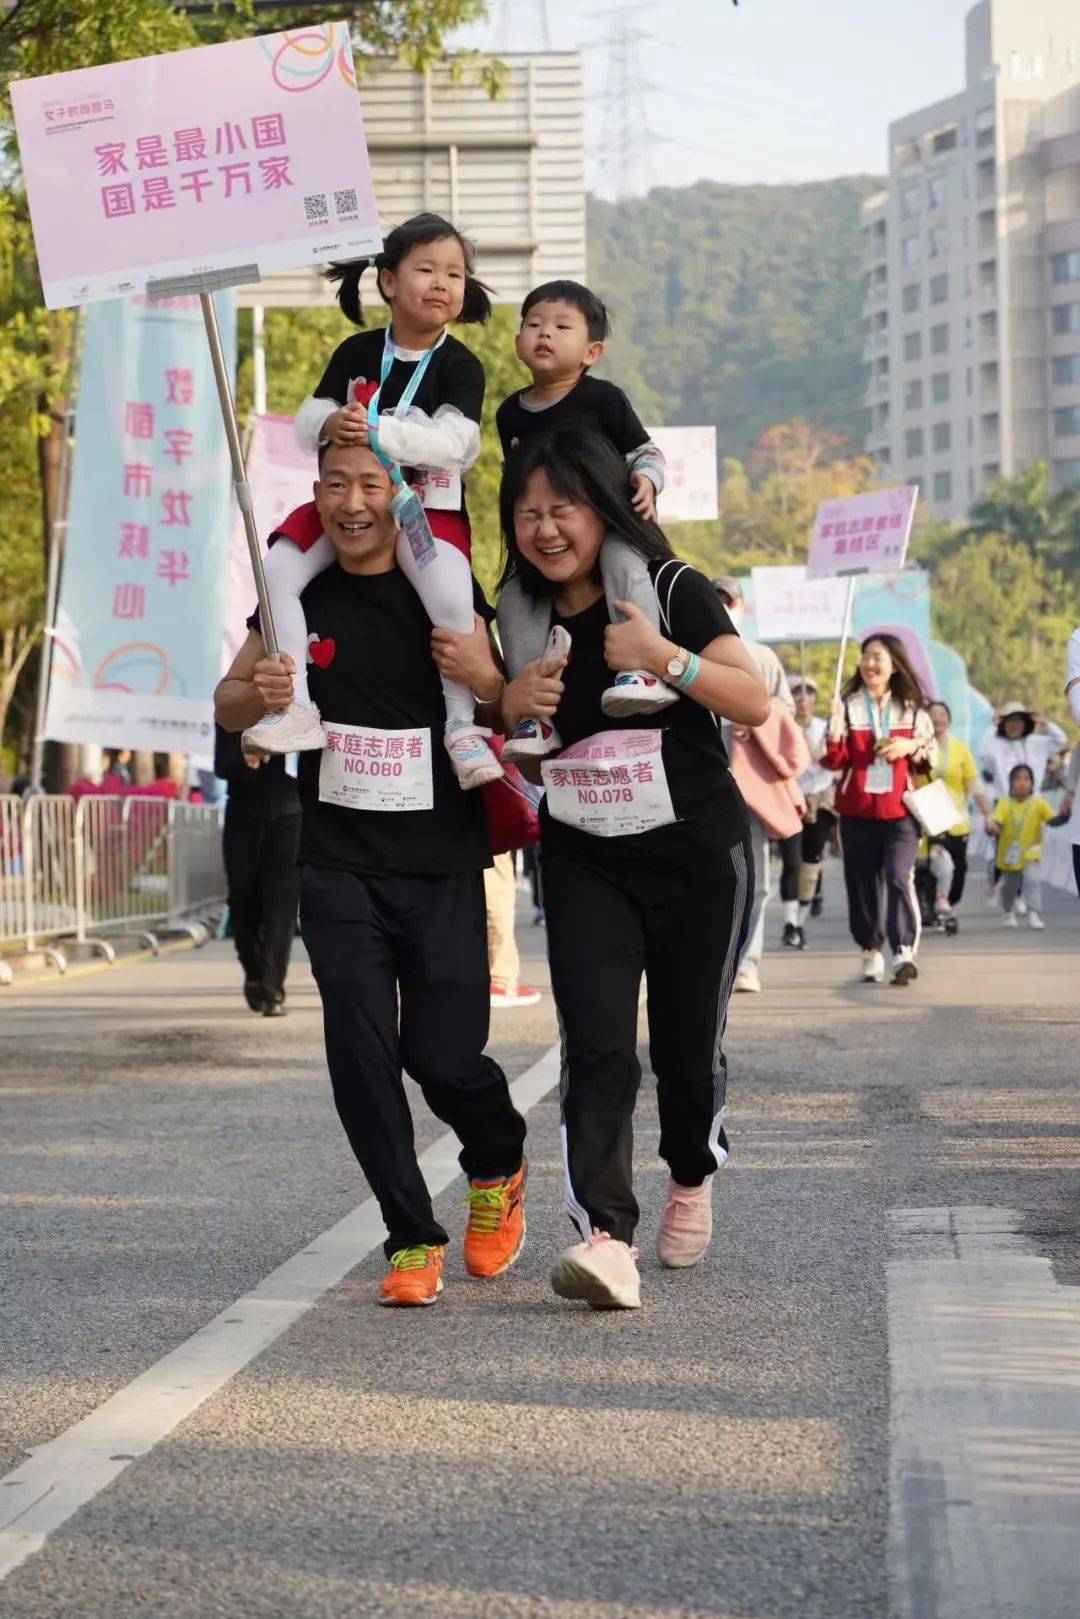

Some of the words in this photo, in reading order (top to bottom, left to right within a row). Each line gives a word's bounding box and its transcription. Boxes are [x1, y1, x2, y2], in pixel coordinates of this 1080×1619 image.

[94, 113, 286, 177] 家是最小国
[101, 156, 294, 218] 国是千万家
[327, 730, 423, 759] 家庭志愿者
[344, 758, 403, 776] NO.080
[550, 761, 654, 787] 家庭志愿者
[578, 788, 634, 804] NO.078
